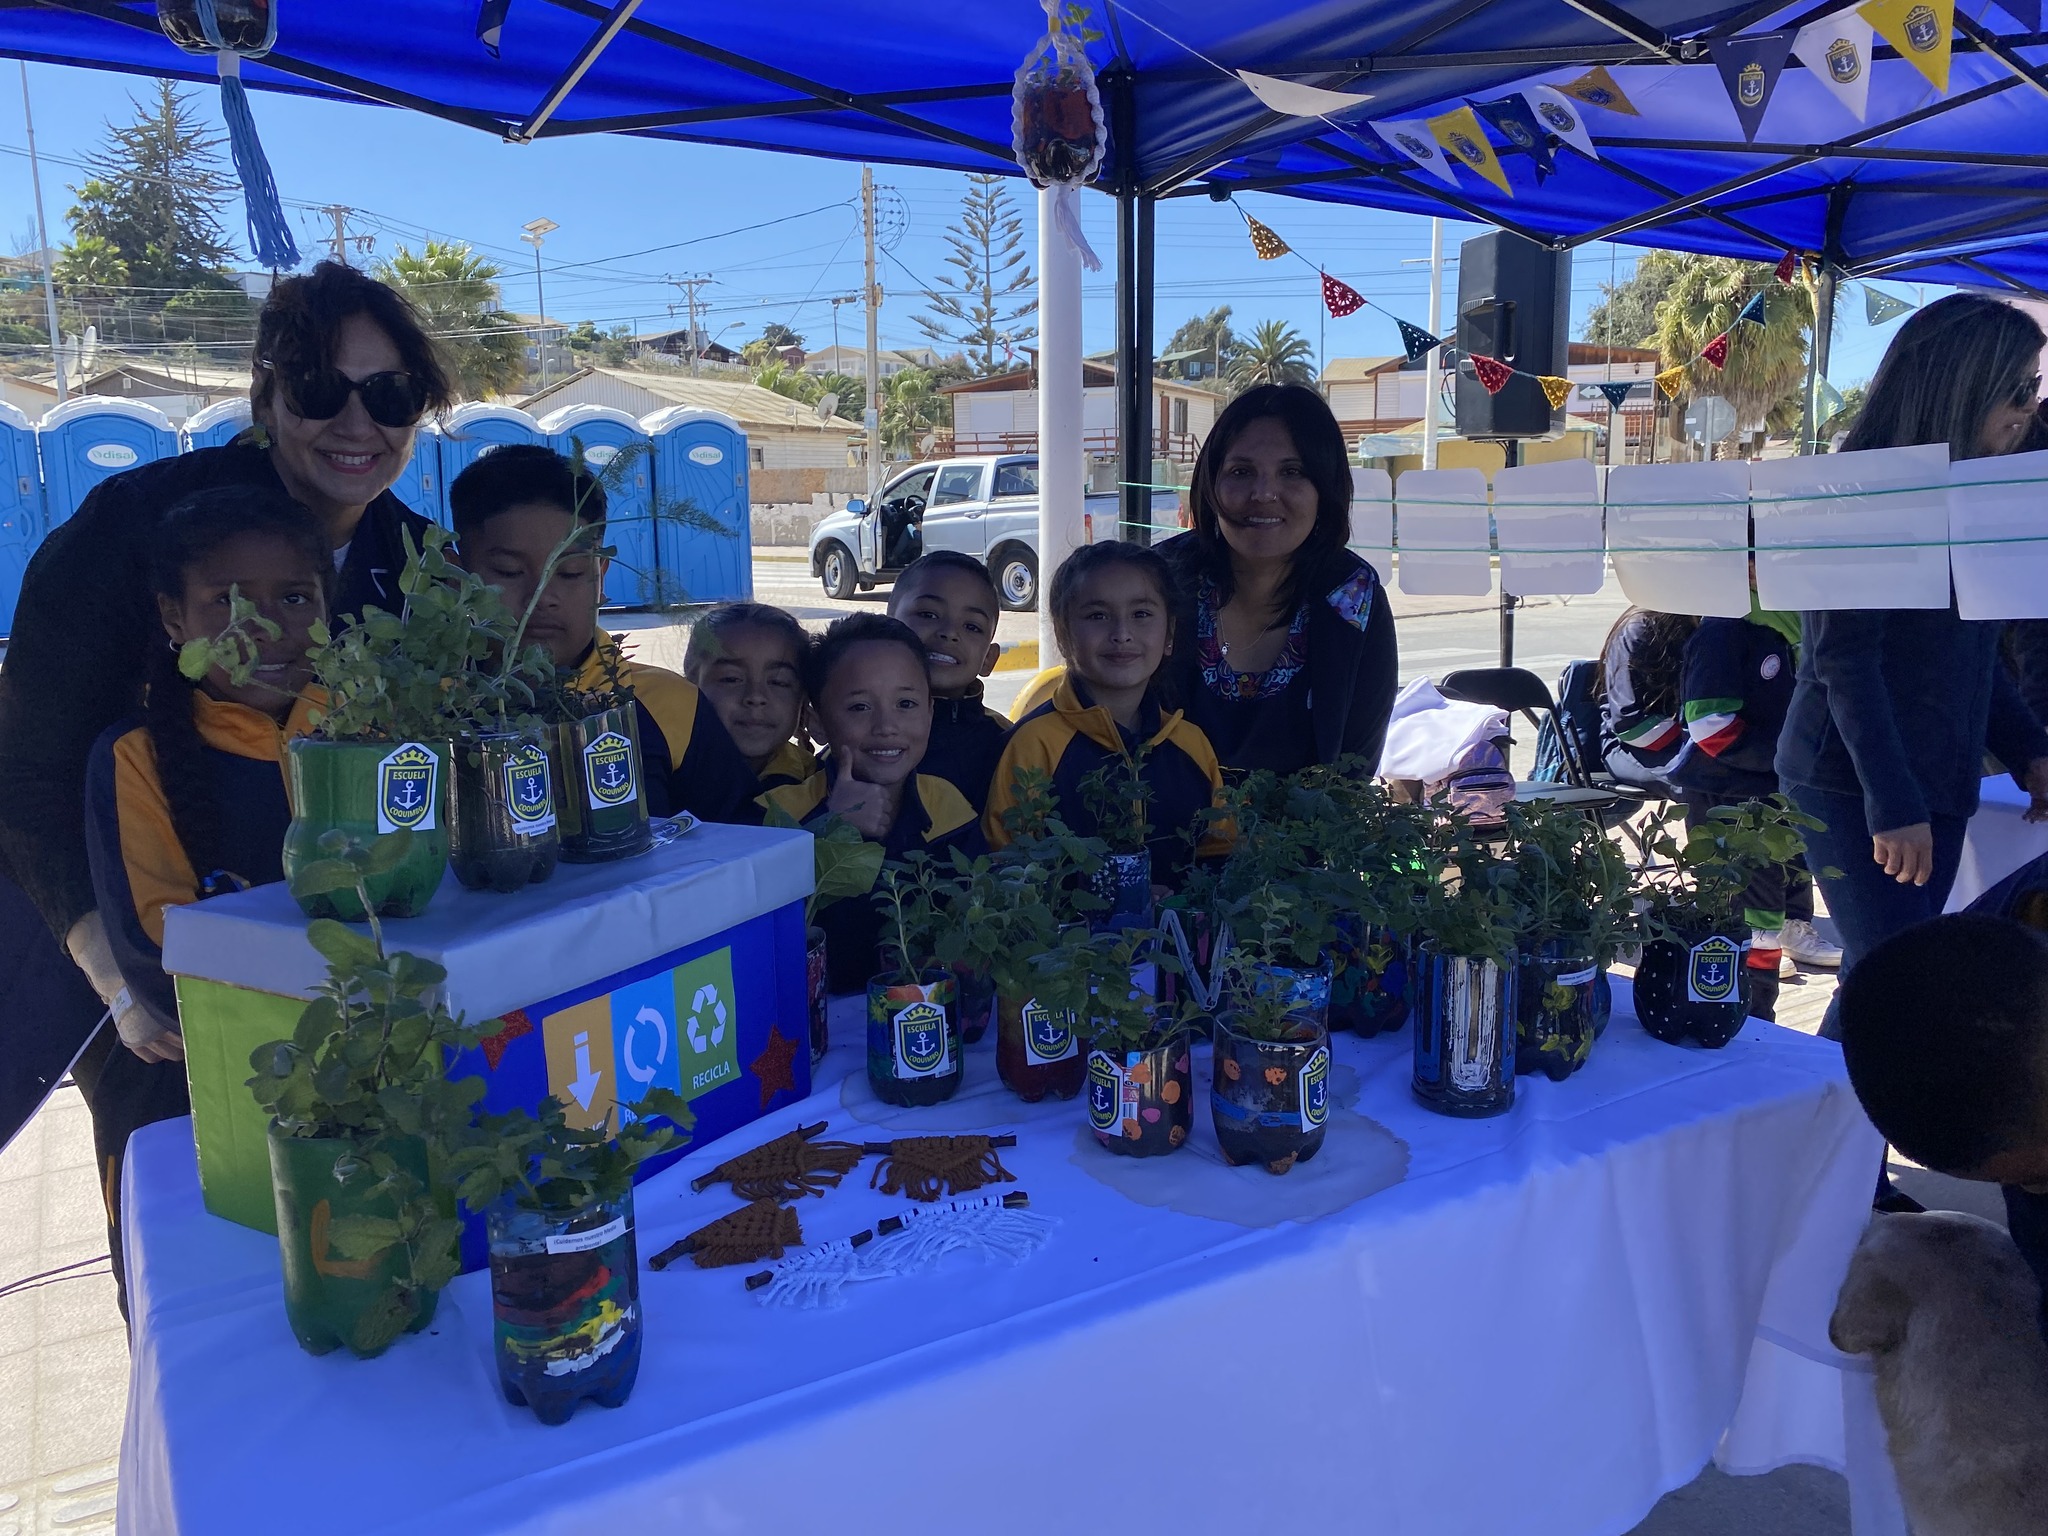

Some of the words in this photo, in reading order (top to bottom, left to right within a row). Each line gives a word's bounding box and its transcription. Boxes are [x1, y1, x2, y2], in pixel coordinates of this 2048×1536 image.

[103, 451, 134, 459] disal
[596, 753, 625, 765] ESCUELA
[393, 771, 425, 780] ESCUELA
[515, 767, 542, 779] ESCUELA
[598, 782, 629, 795] COQUIMBO
[390, 806, 423, 817] COQUIMBO
[1697, 983, 1728, 992] COQUIMBO
[1034, 1011, 1064, 1022] ESCULA
[907, 1022, 936, 1033] ESCUELA
[1036, 1039, 1067, 1051] COQUIMBO
[909, 1051, 939, 1063] COQUIMBO
[692, 1061, 730, 1089] RECICLA
